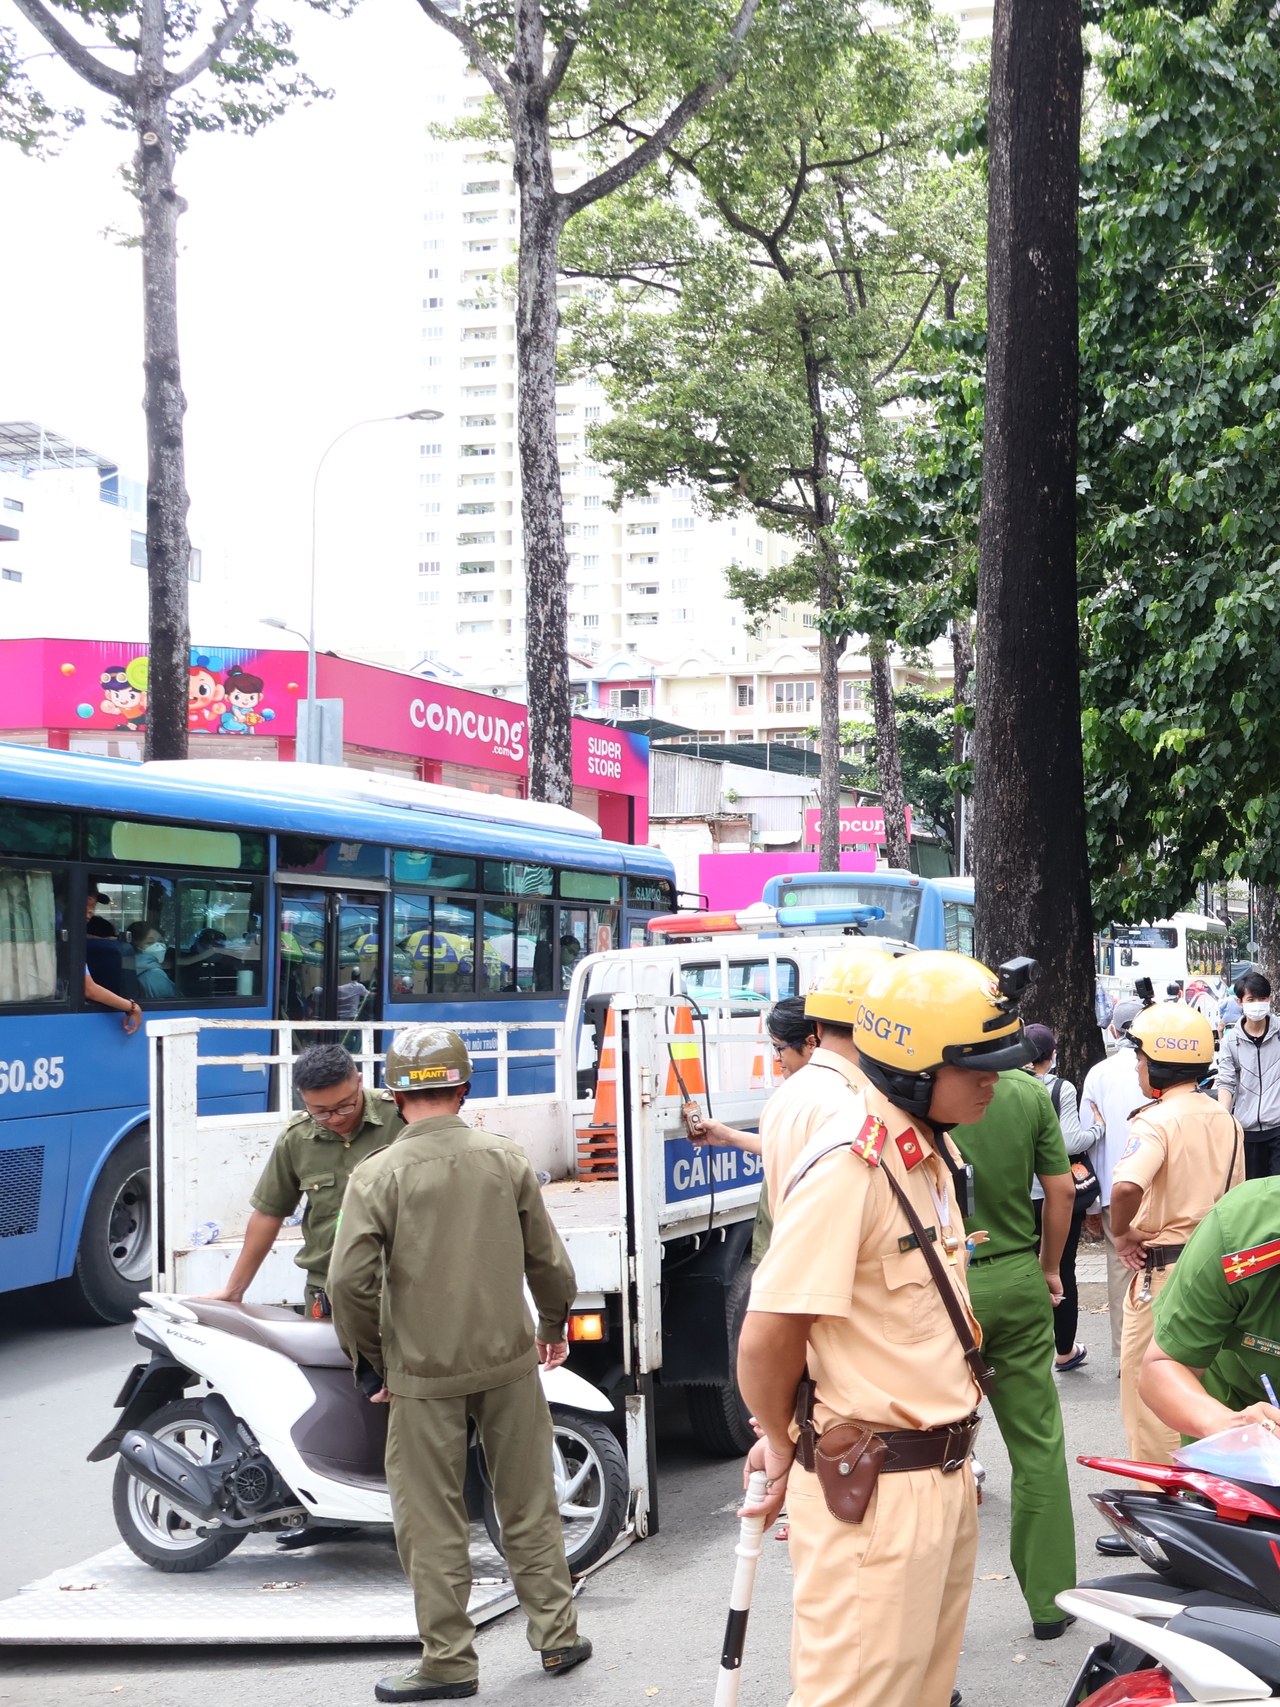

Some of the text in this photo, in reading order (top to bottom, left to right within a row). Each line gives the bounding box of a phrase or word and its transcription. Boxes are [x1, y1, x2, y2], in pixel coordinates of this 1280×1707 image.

[635, 887, 662, 901] SAMCO
[857, 1004, 912, 1046] CSGT
[1155, 1037, 1199, 1051] CSGT
[673, 1146, 738, 1191] CẢNH
[166, 1328, 207, 1346] VISION
